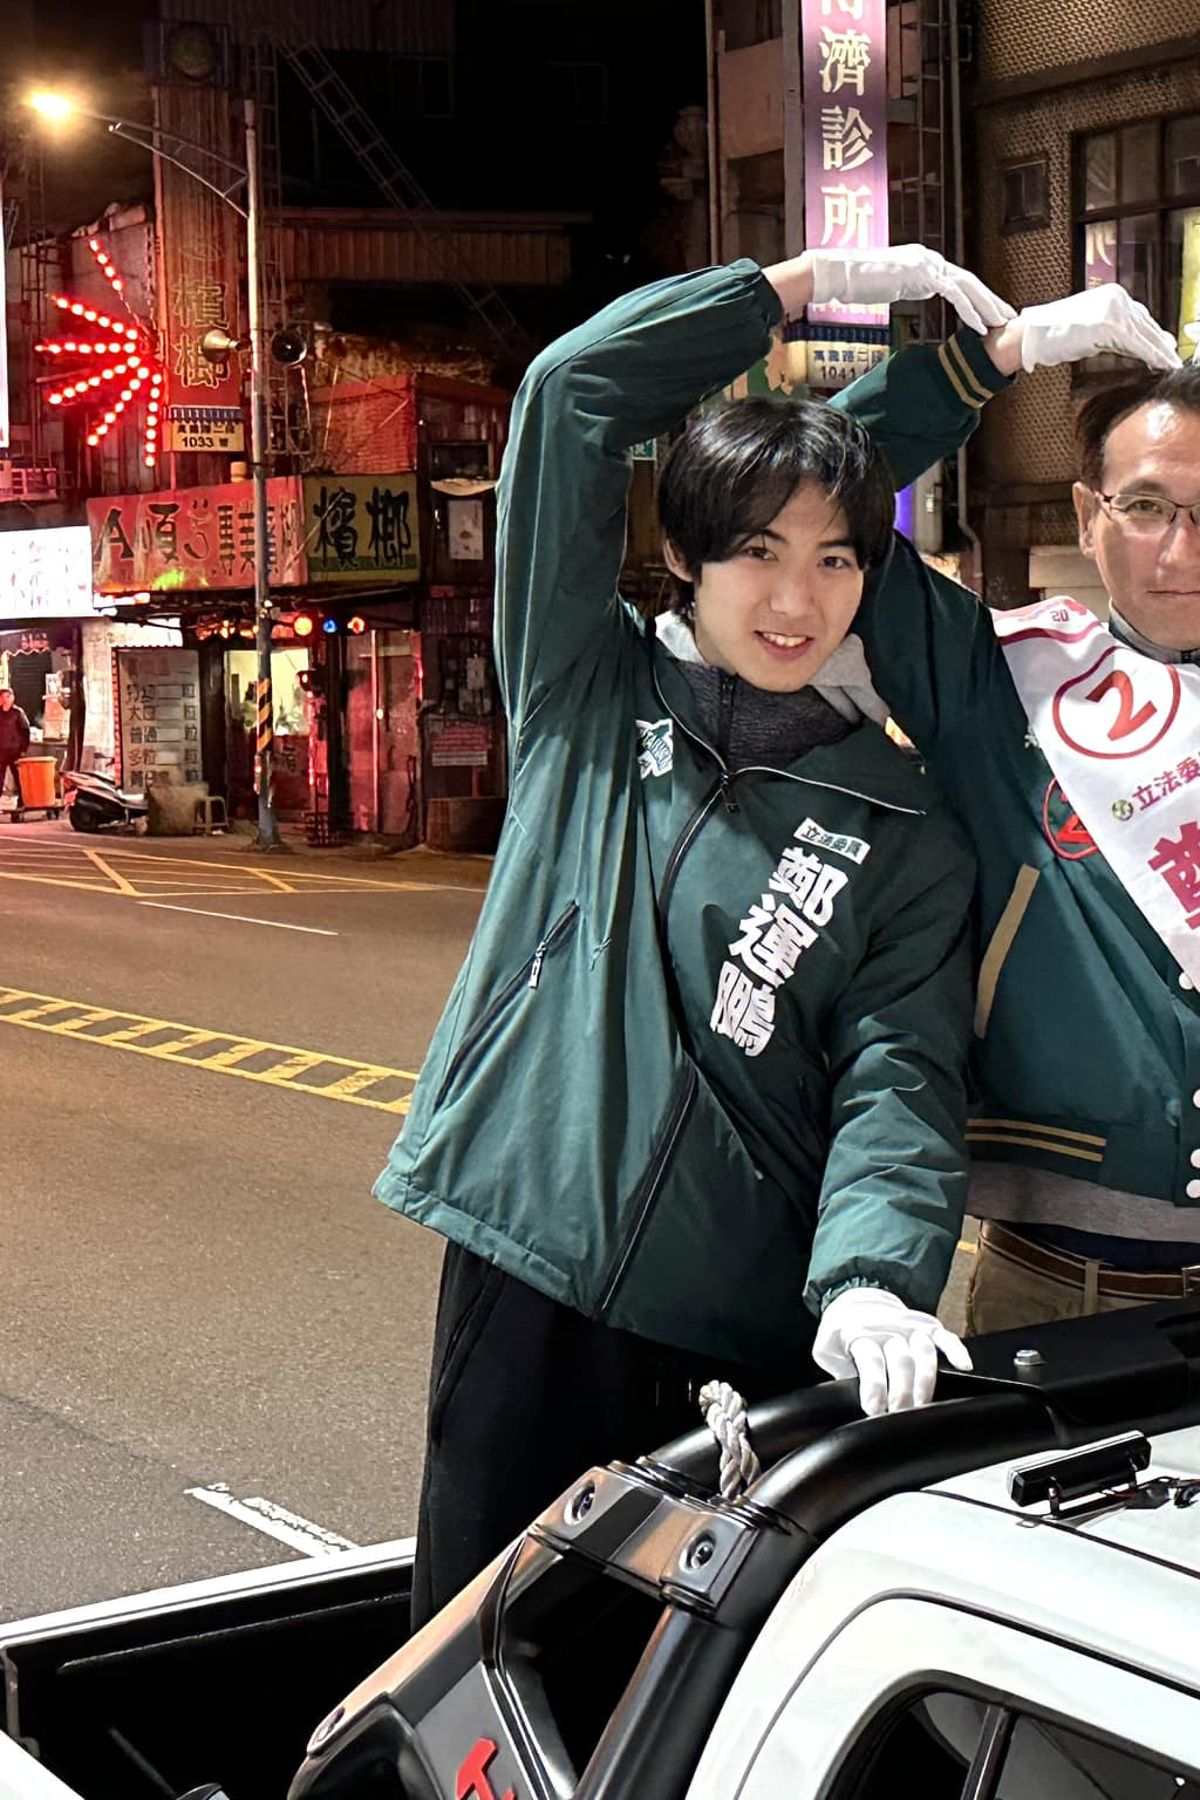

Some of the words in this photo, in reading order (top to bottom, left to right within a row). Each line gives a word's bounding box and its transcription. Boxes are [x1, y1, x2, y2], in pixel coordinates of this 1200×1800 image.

[801, 824, 864, 860] 立法委員
[709, 846, 850, 1058] 鄭運鵬
